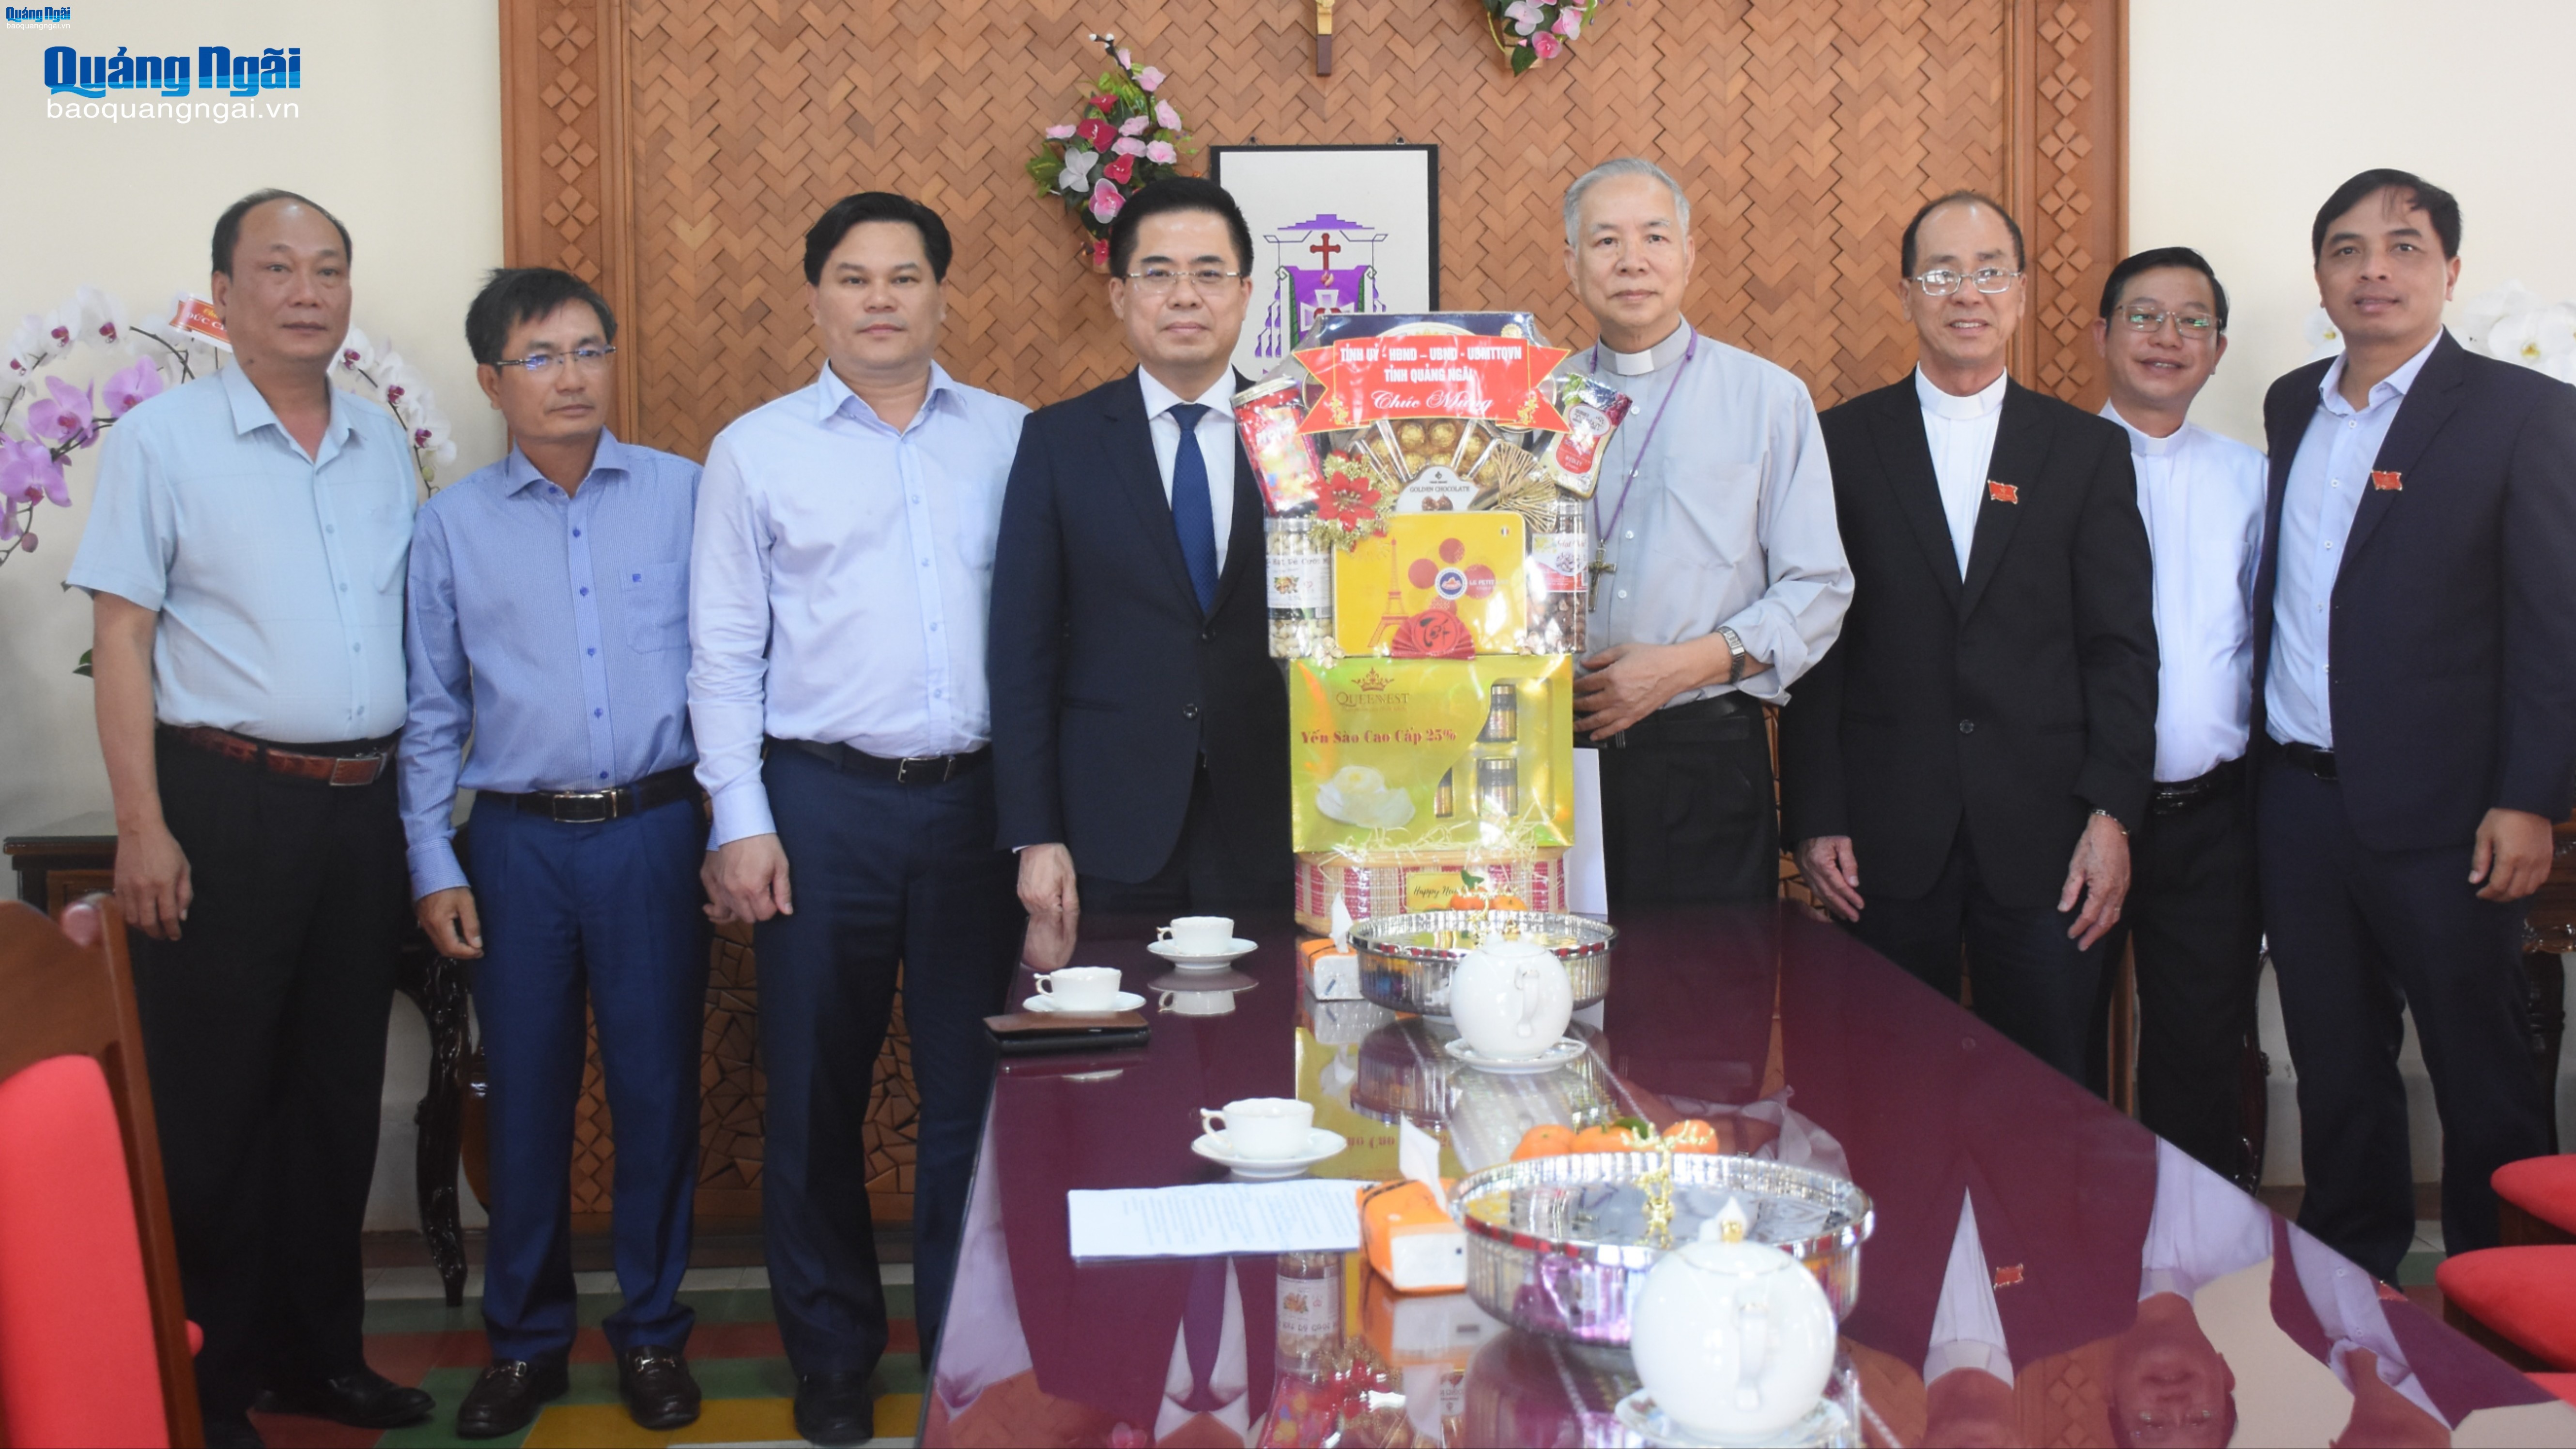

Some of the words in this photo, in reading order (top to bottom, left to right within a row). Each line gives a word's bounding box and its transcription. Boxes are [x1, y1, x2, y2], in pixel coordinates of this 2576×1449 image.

[1340, 343, 1364, 361] TỈNH
[1429, 347, 1458, 361] UBND
[1467, 346, 1522, 360] UBMTTQVN
[1384, 364, 1408, 382] TỈNH
[1410, 363, 1446, 384] QUẢNG
[1371, 390, 1421, 409] Chúc
[1301, 729, 1328, 744] Yến
[1333, 730, 1360, 744] Sào
[1364, 730, 1391, 743] Cao
[1394, 727, 1422, 745] Cấp
[1426, 728, 1456, 741] 25%
[1413, 885, 1440, 898] Happy
